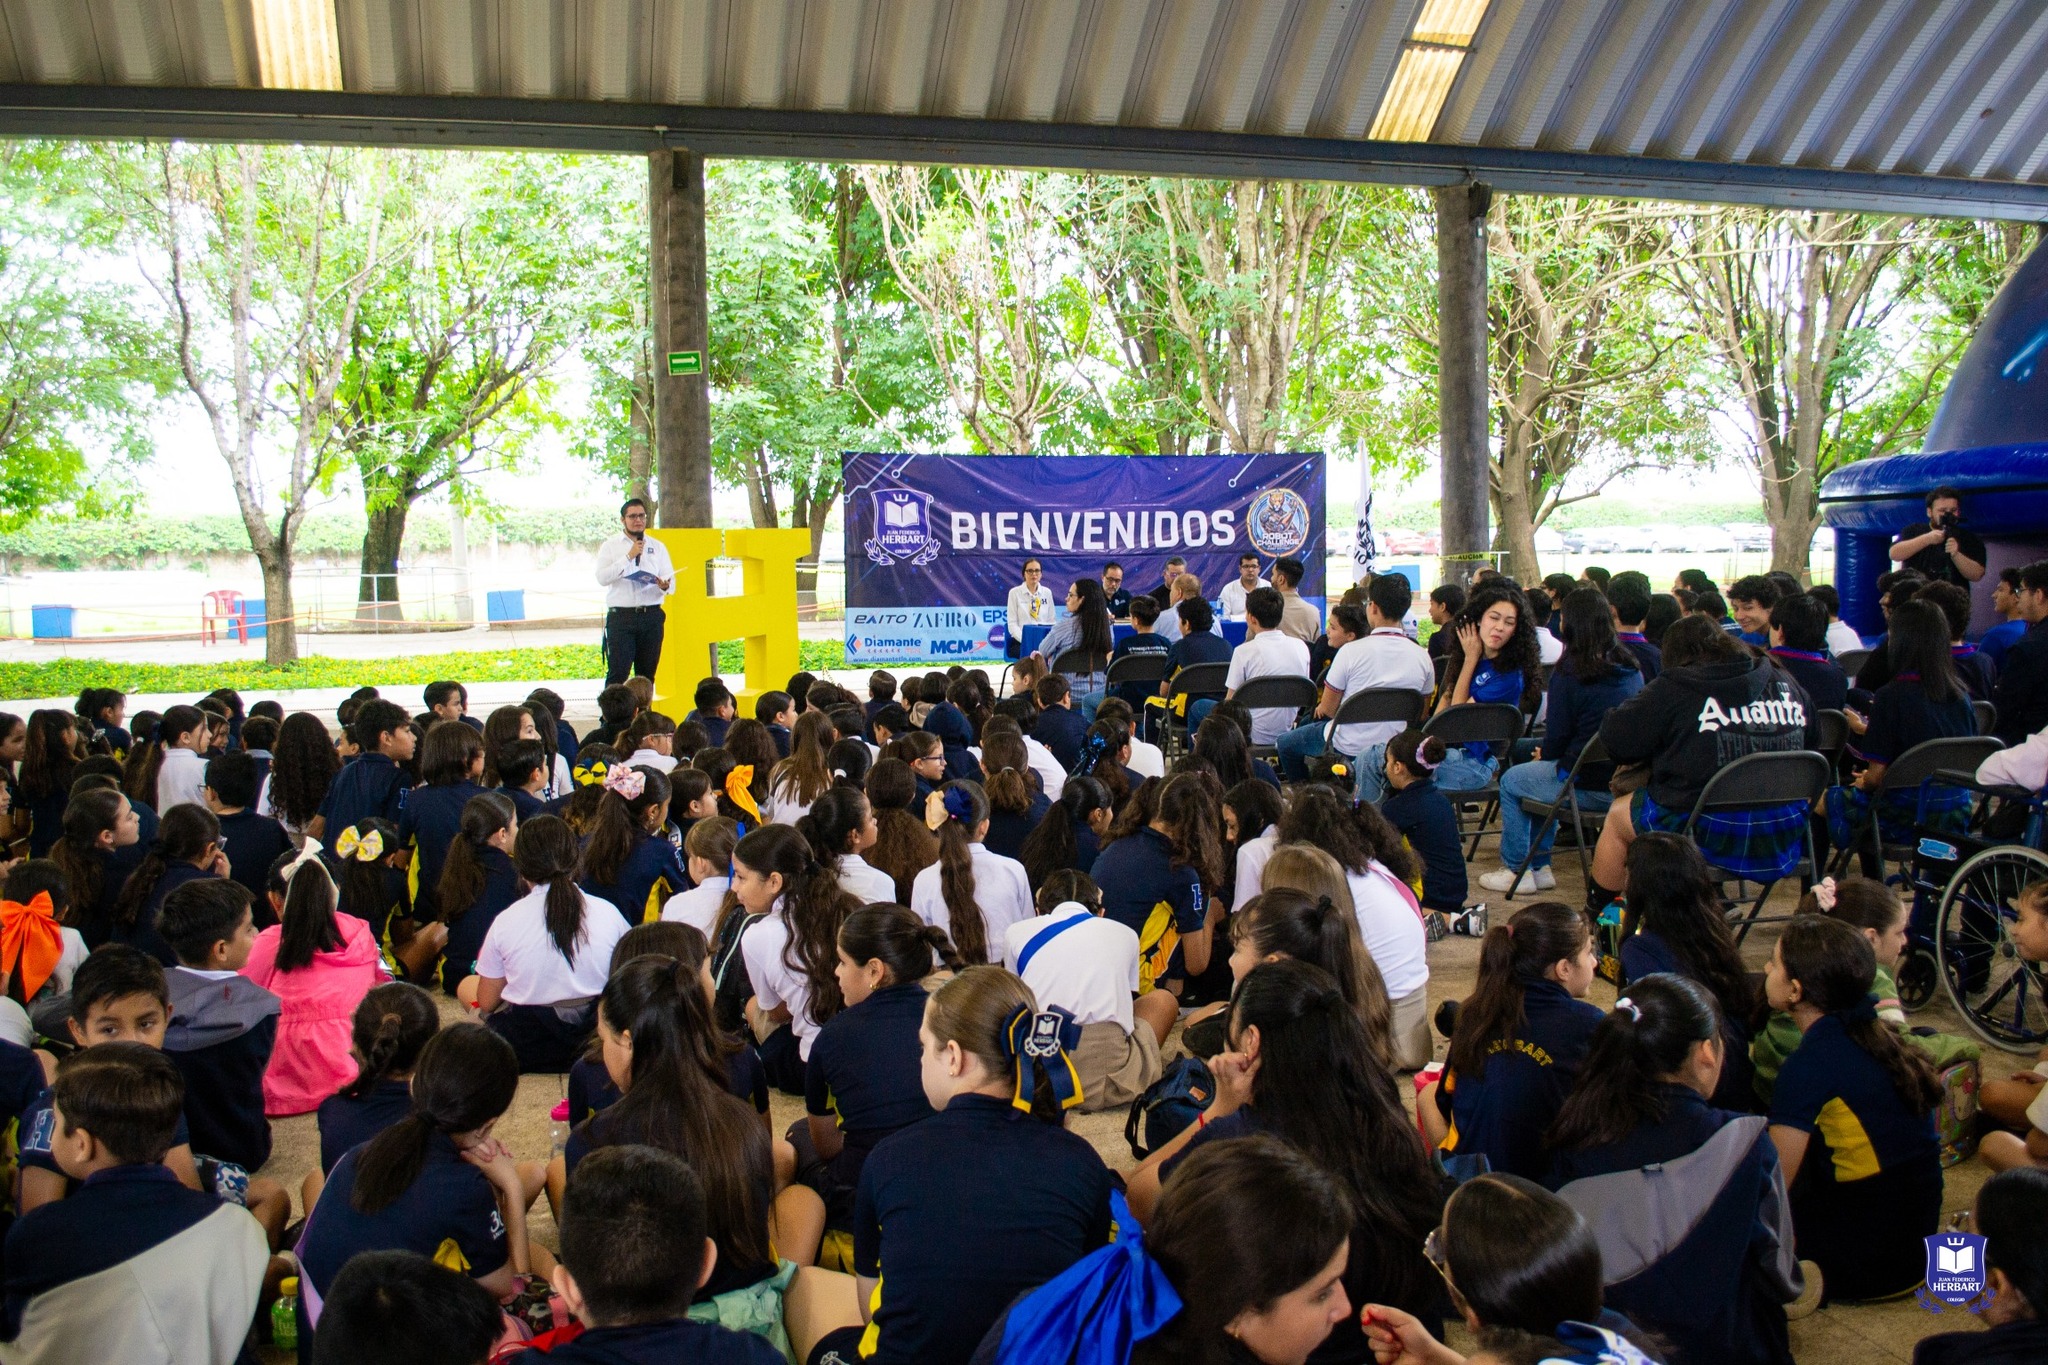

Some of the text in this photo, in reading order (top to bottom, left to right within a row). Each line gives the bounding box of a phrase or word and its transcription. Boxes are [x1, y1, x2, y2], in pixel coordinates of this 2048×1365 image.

[951, 510, 1236, 550] BIENVENIDOS
[1263, 532, 1293, 540] ROBOT
[882, 535, 925, 544] HERBART
[913, 613, 977, 628] ZAFIRO
[865, 635, 973, 654] Diamante MCM
